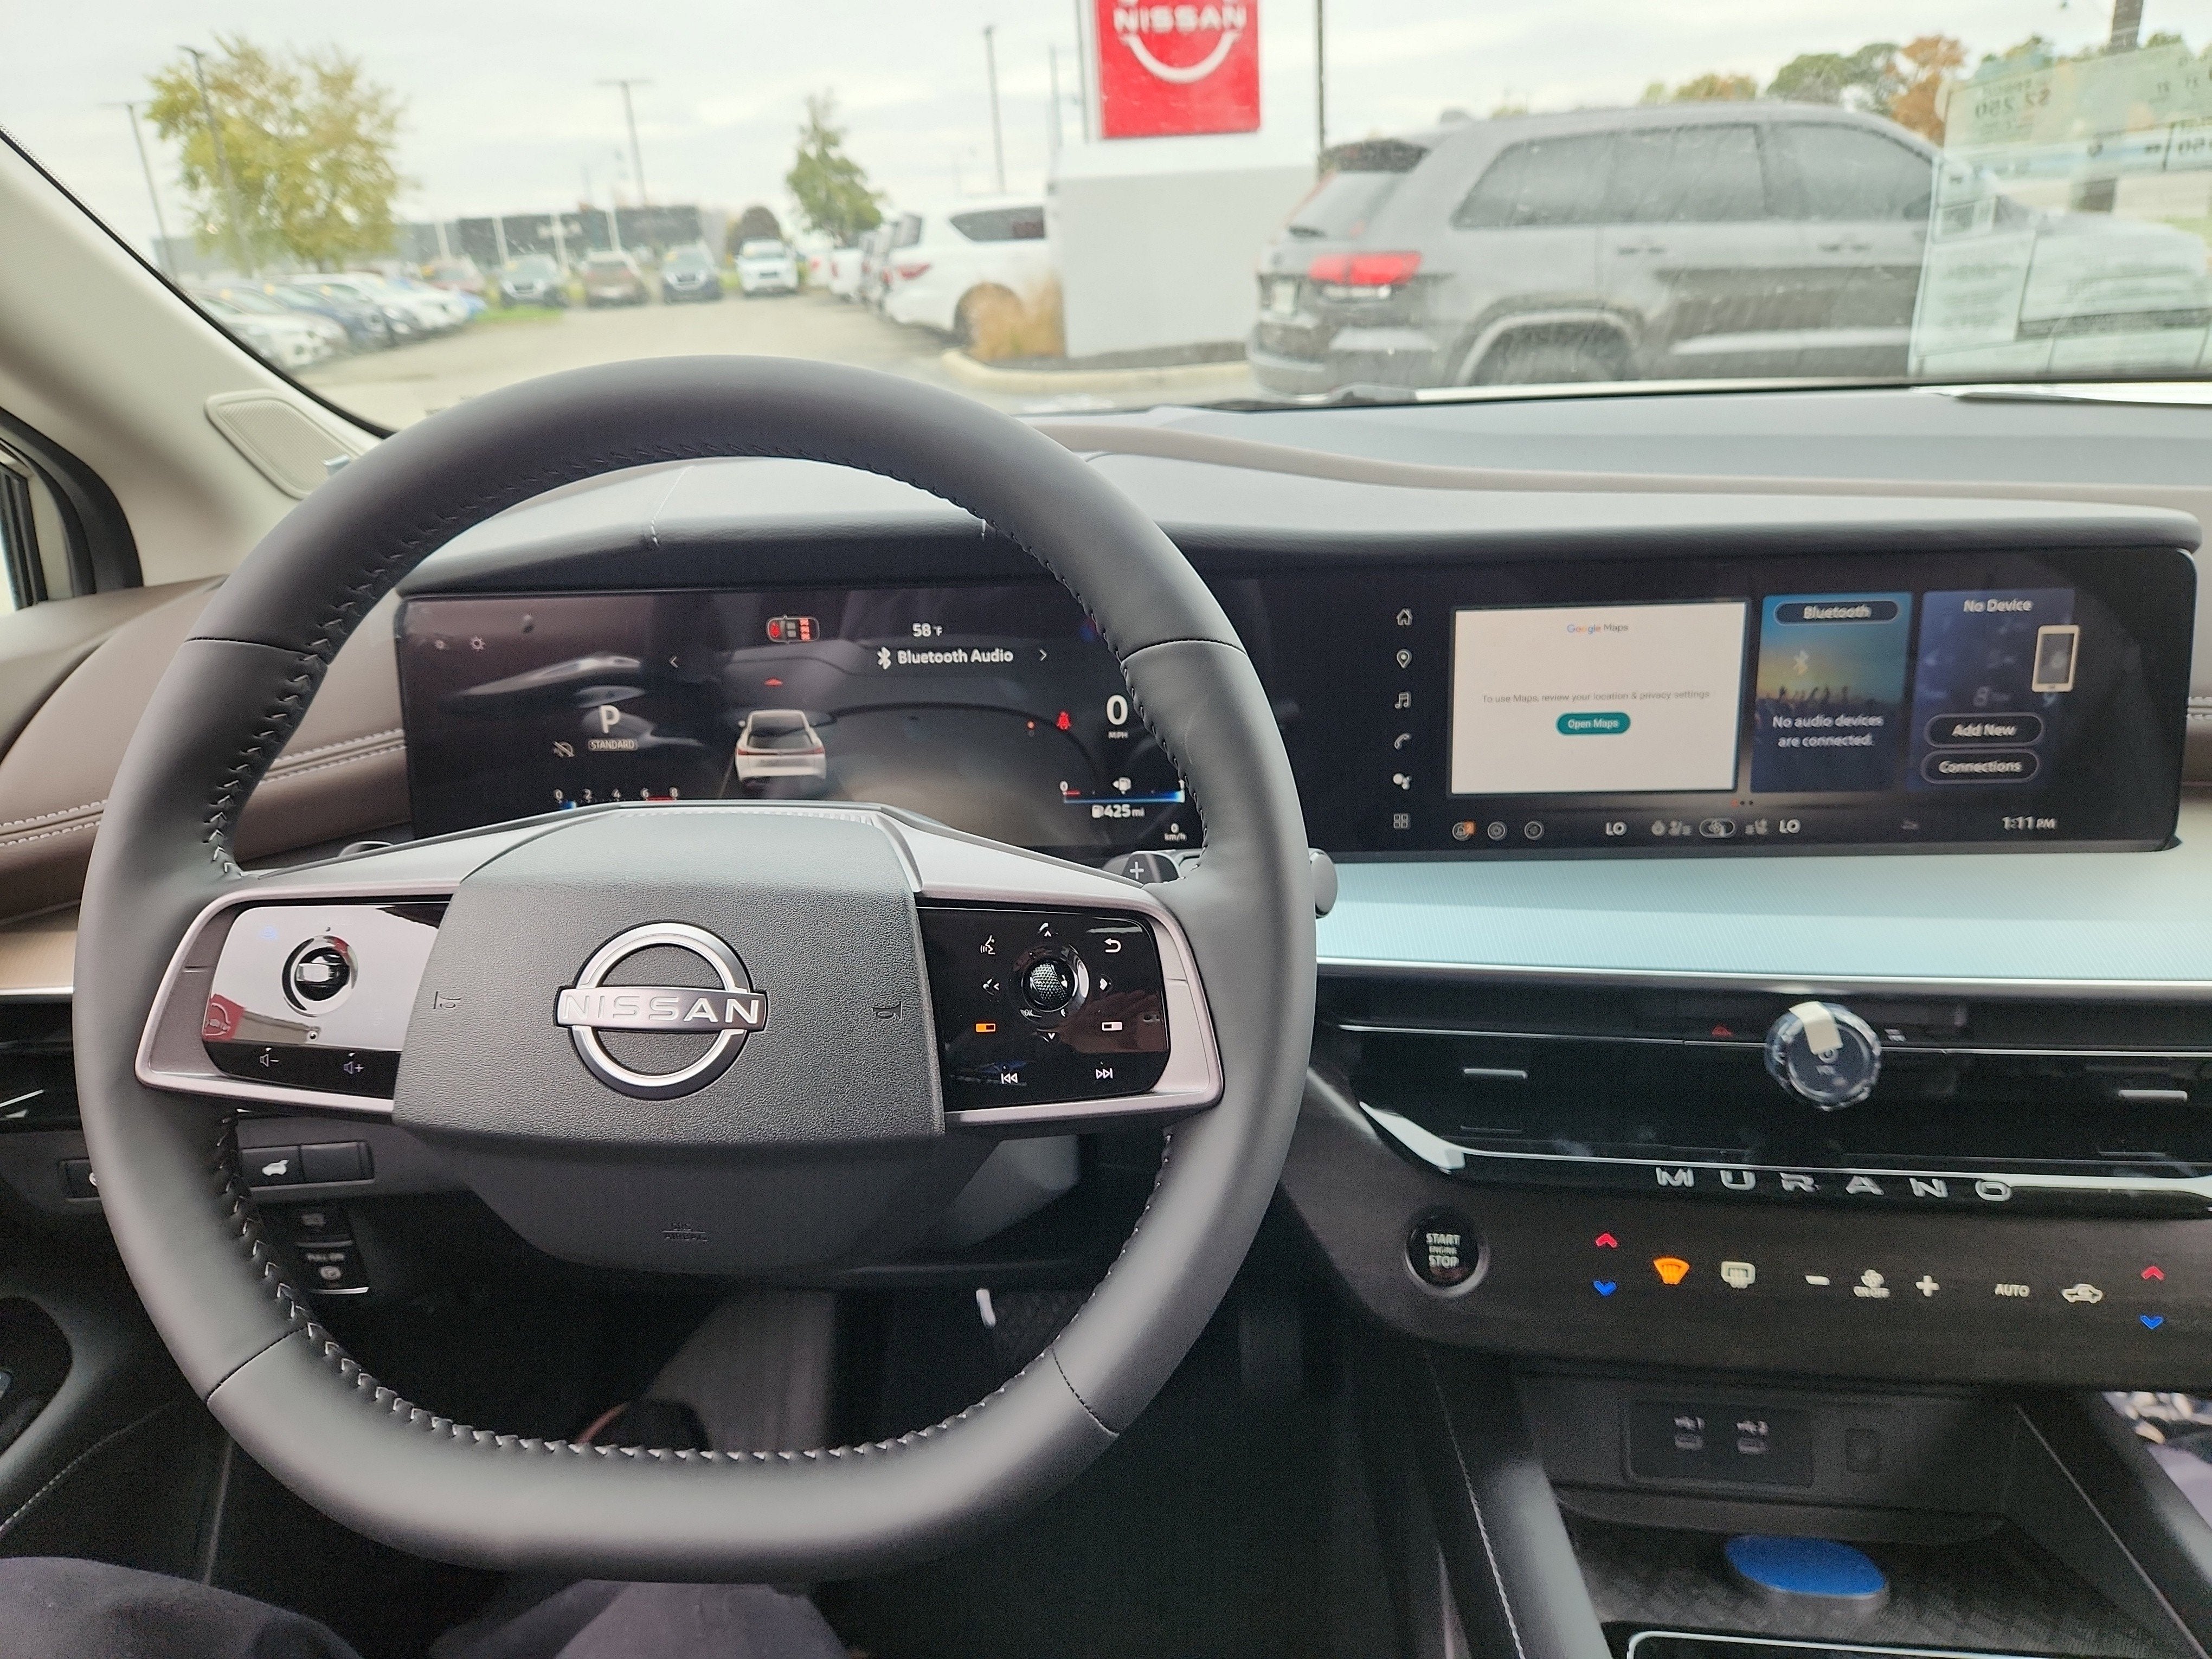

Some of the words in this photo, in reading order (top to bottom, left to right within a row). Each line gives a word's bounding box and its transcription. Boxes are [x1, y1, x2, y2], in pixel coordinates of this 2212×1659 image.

[1113, 4, 1247, 34] NISSAN
[1803, 605, 1871, 619] Bluetooth
[1963, 599, 1984, 612] No
[1987, 598, 2033, 612] Device
[912, 623, 931, 636] 58
[1567, 624, 1601, 635] Google
[1604, 623, 1629, 633] Maps
[897, 648, 968, 664] Bluetooth
[970, 647, 1013, 663] Audio
[1483, 695, 1493, 703] To
[1513, 694, 1539, 704] Maps,
[1542, 693, 1569, 702] review
[1572, 693, 1590, 703] your
[1593, 691, 1629, 700] location
[1631, 691, 1637, 700] &
[1639, 691, 1671, 701] privacy
[1674, 690, 1709, 700] settings
[1107, 695, 1128, 725] 0
[600, 705, 620, 734] P
[1567, 719, 1591, 731] Open
[1593, 718, 1618, 729] Maps
[1772, 715, 1793, 728] No
[1794, 713, 1834, 728] audio
[1835, 713, 1884, 727] devices
[1952, 724, 1983, 737] Add
[1983, 723, 2017, 736] New
[589, 739, 635, 750] STANDARD
[1778, 737, 1801, 748] are
[1939, 761, 2023, 774] Connections
[1059, 780, 1068, 792] 0
[553, 789, 563, 800] 0
[583, 788, 591, 800] 2
[612, 788, 621, 799] 4
[640, 788, 649, 799] 6
[669, 787, 678, 798] 8
[1104, 804, 1131, 818] 425
[1131, 807, 1145, 818] mi
[1171, 822, 1179, 834] 0
[1605, 821, 1627, 836] LO
[1779, 819, 1801, 834] LO
[2002, 816, 2033, 831] 1:11
[2036, 818, 2056, 830] PM
[1165, 833, 1187, 841] km/h
[563, 995, 759, 1024] NISSAN
[1656, 1166, 2012, 1201] MURANO
[1426, 1233, 1461, 1245] START
[1429, 1255, 1459, 1269] STOP
[1995, 1283, 2030, 1297] AUTO
